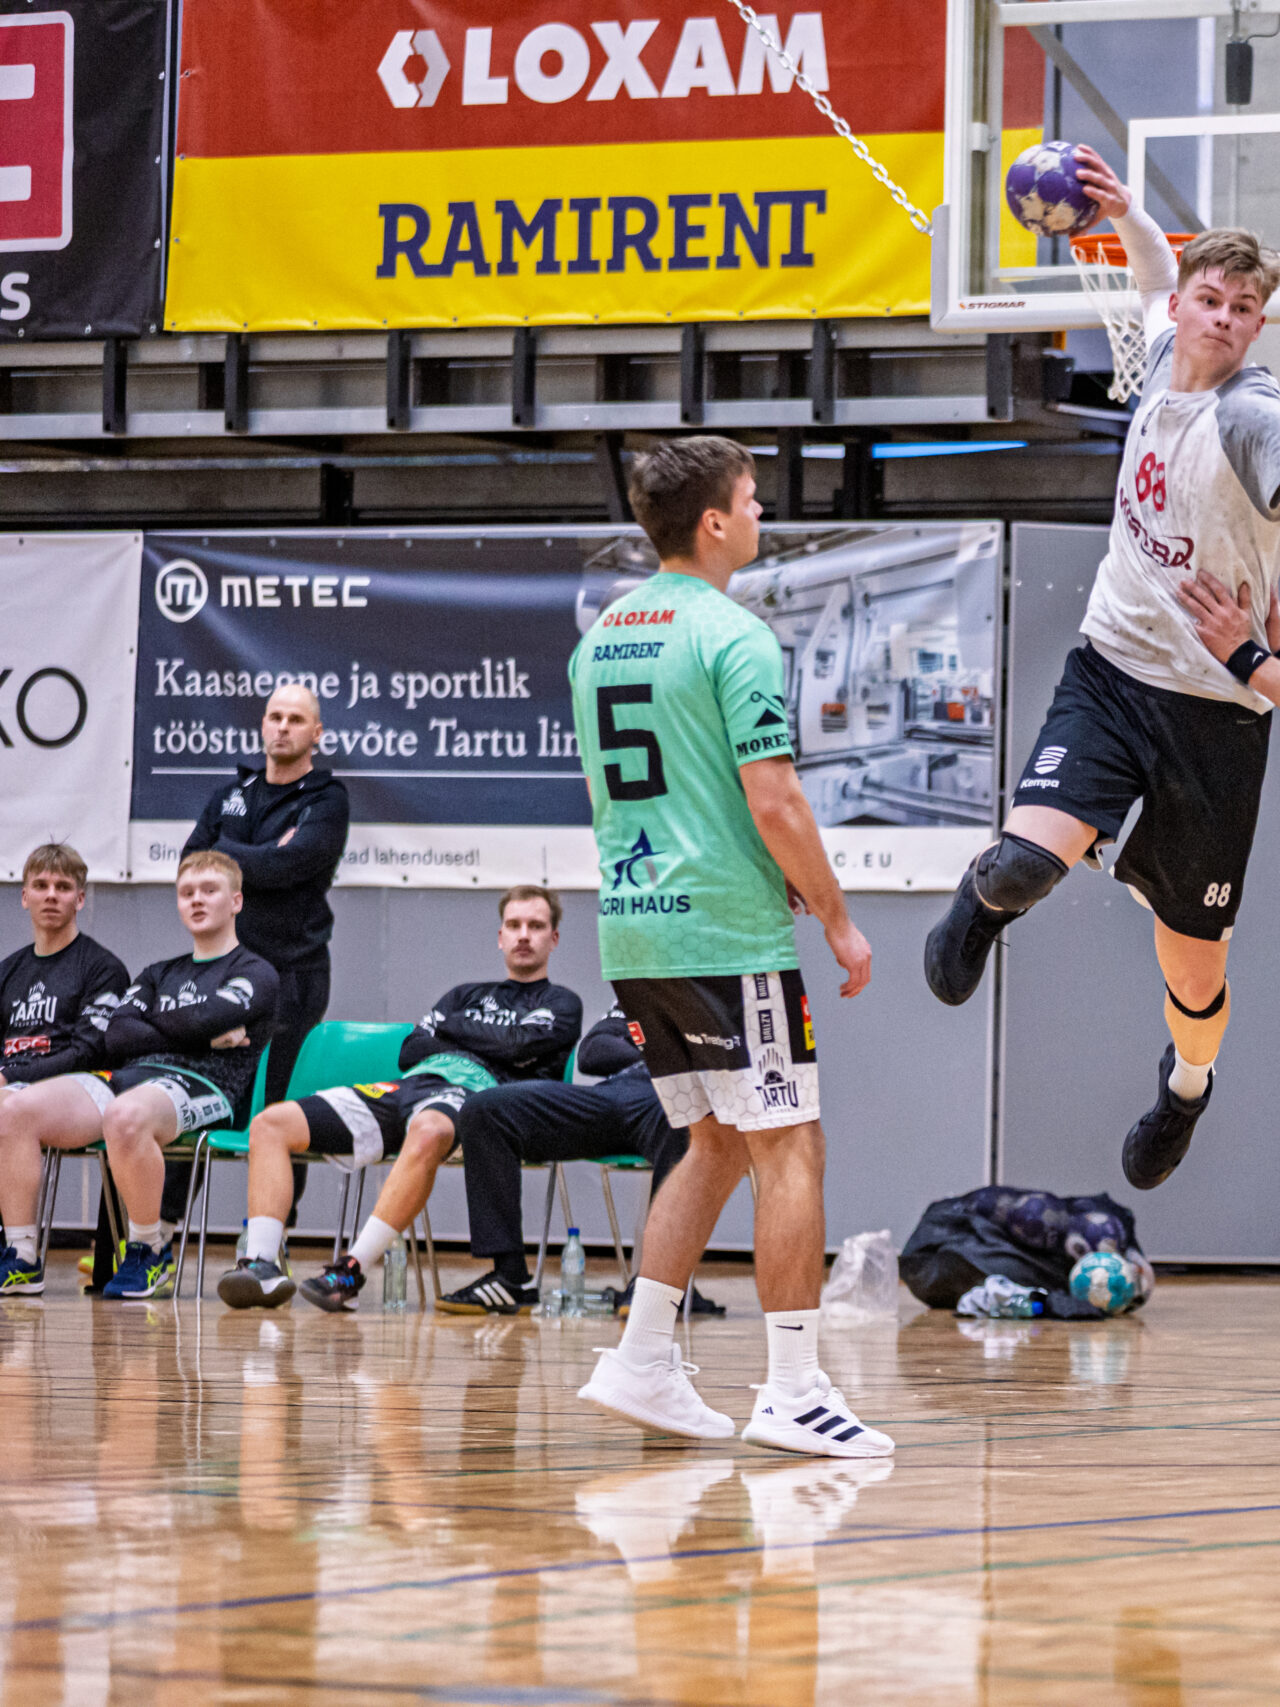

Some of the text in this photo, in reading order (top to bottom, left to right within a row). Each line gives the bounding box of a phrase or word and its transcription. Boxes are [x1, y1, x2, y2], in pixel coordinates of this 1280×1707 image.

[462, 12, 829, 105] LOXAM
[376, 189, 827, 279] RAMIRENT
[968, 301, 1026, 310] STIGMAR
[221, 575, 370, 607] METEC
[615, 609, 676, 627] LOXAM
[592, 642, 664, 662] RAMIRENT
[346, 661, 382, 709] ja
[390, 657, 531, 709] sportlik
[429, 717, 528, 758] Tartu
[537, 715, 582, 757] lin
[597, 683, 668, 801] 5
[1020, 778, 1060, 789] Kempa
[374, 846, 480, 866] lahendused!
[599, 894, 691, 916] GRI HAUS
[1203, 882, 1232, 907] 88
[755, 1080, 799, 1112] TARTU
